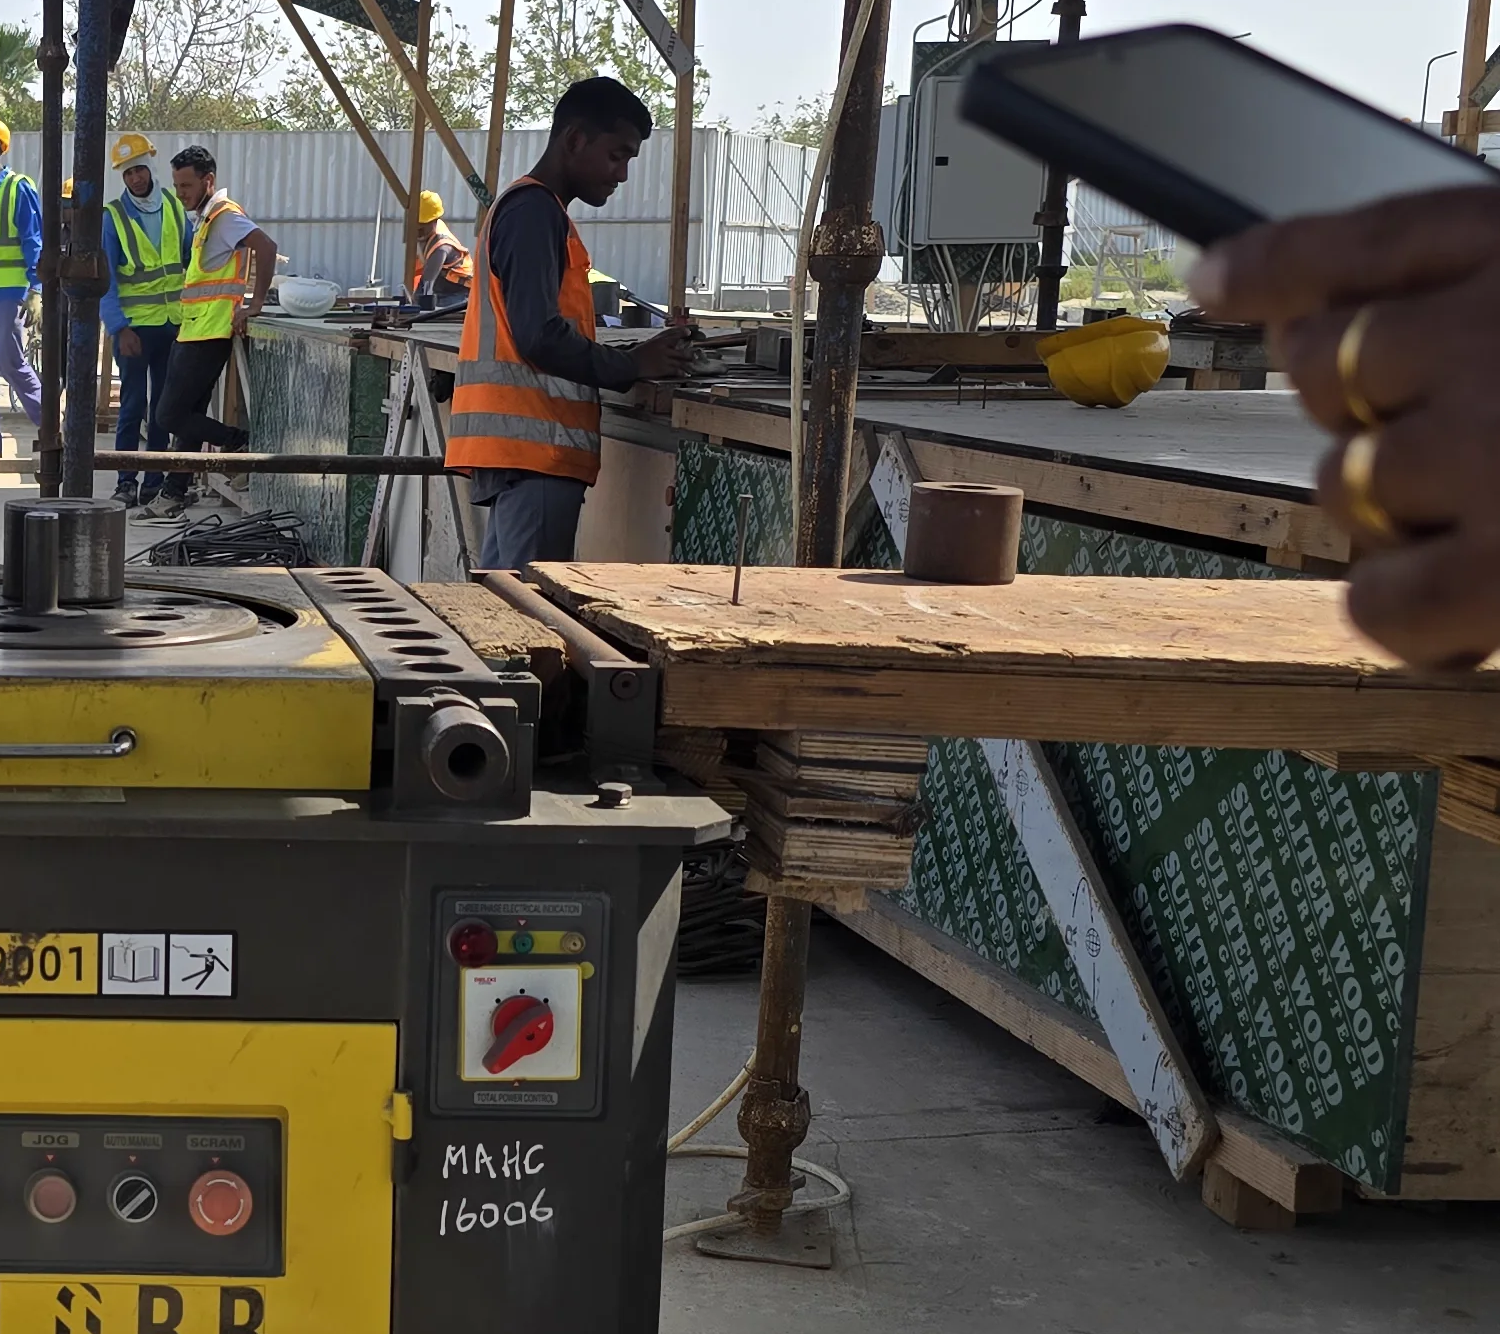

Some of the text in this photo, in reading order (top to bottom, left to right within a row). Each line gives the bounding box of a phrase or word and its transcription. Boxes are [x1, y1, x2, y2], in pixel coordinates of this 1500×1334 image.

[987, 858, 1021, 969] WOOD
[1152, 866, 1185, 963] SUPER
[1164, 850, 1223, 1025] SULITER
[1184, 833, 1219, 932] SUPER
[1253, 762, 1290, 865] SUPER
[1290, 877, 1366, 1090] GREEN-TECH
[1267, 749, 1334, 930] SULITER
[1330, 930, 1384, 1075] WOOD
[1197, 817, 1303, 1134] SULITER WOOD
[1218, 798, 1326, 1119] SUPER GREEN-TECH
[1231, 782, 1343, 1106] SULITER WOOD
[32, 1134, 69, 1145] JOG
[190, 1137, 242, 1148] SCRAM
[477, 1093, 497, 1102] TOTAL
[439, 1188, 553, 1236] 16006
